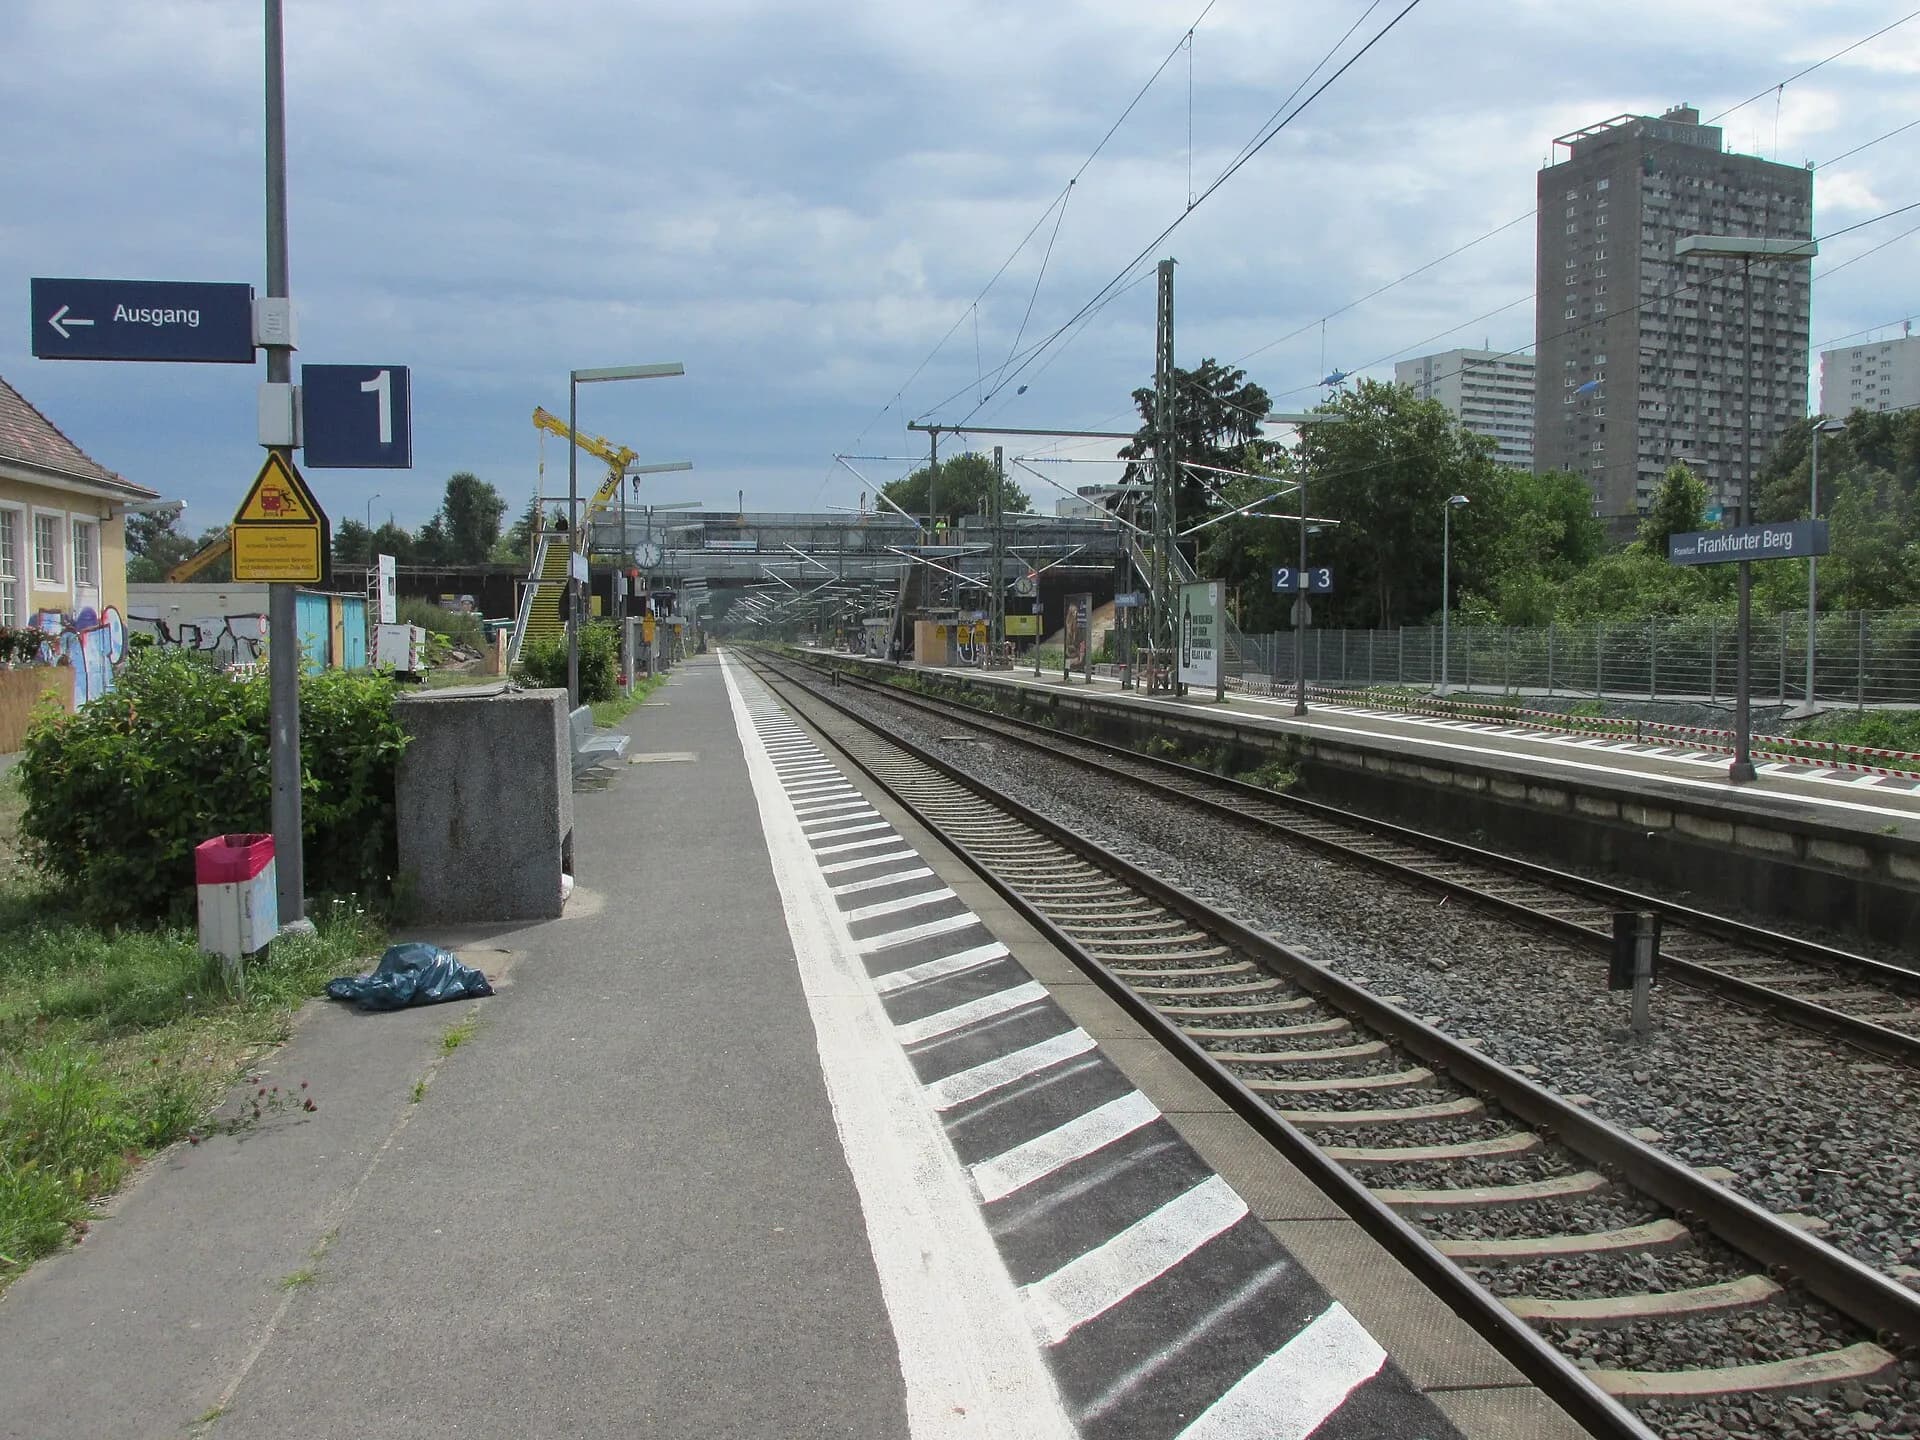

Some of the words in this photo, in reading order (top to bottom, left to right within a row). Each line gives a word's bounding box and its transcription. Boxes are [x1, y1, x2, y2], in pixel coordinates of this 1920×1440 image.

[113, 303, 200, 327] Ausgang
[360, 369, 392, 443] 1
[1697, 534, 1760, 554] Frankfurter
[1764, 531, 1792, 549] Berg
[1276, 568, 1289, 588] 2
[1318, 568, 1330, 588] 3
